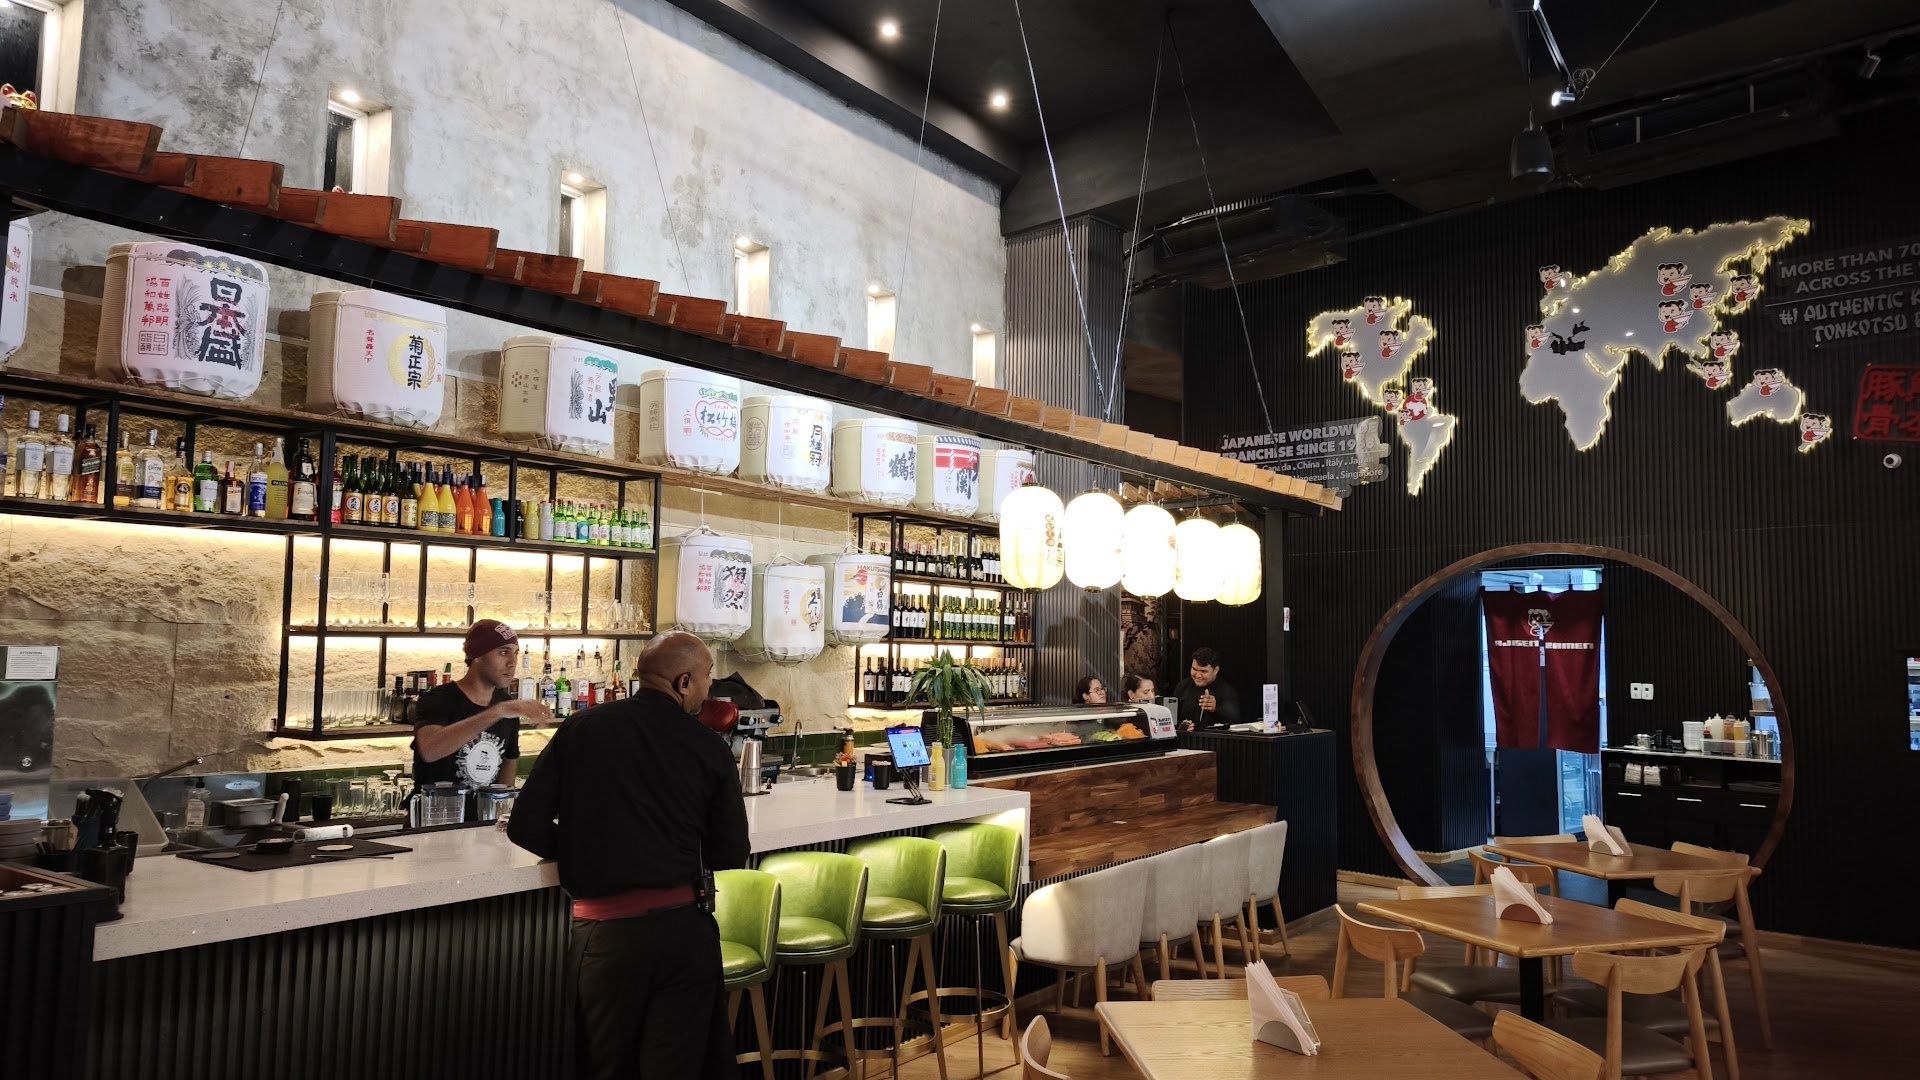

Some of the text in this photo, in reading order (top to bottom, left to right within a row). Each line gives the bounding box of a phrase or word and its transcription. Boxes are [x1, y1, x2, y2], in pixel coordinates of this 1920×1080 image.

[1781, 258, 1835, 279] MORE
[1839, 247, 1892, 268] THAN
[1796, 263, 1914, 294] ACROSS THE
[1803, 291, 1904, 321] AUTHENTIC
[197, 277, 246, 370] 日本盛
[1812, 314, 1908, 342] TONKOTSU
[407, 334, 424, 390] 菊正宗
[809, 424, 823, 467] 月桂冠
[1221, 422, 1377, 450] JAPANESE WORLDWIDE
[1295, 441, 1335, 456] SINCE
[1297, 460, 1320, 470] China
[1326, 457, 1343, 467] Italy
[1348, 456, 1374, 466] Japan
[1340, 469, 1383, 480] Singapore
[1545, 642, 1594, 650] RAMEN
